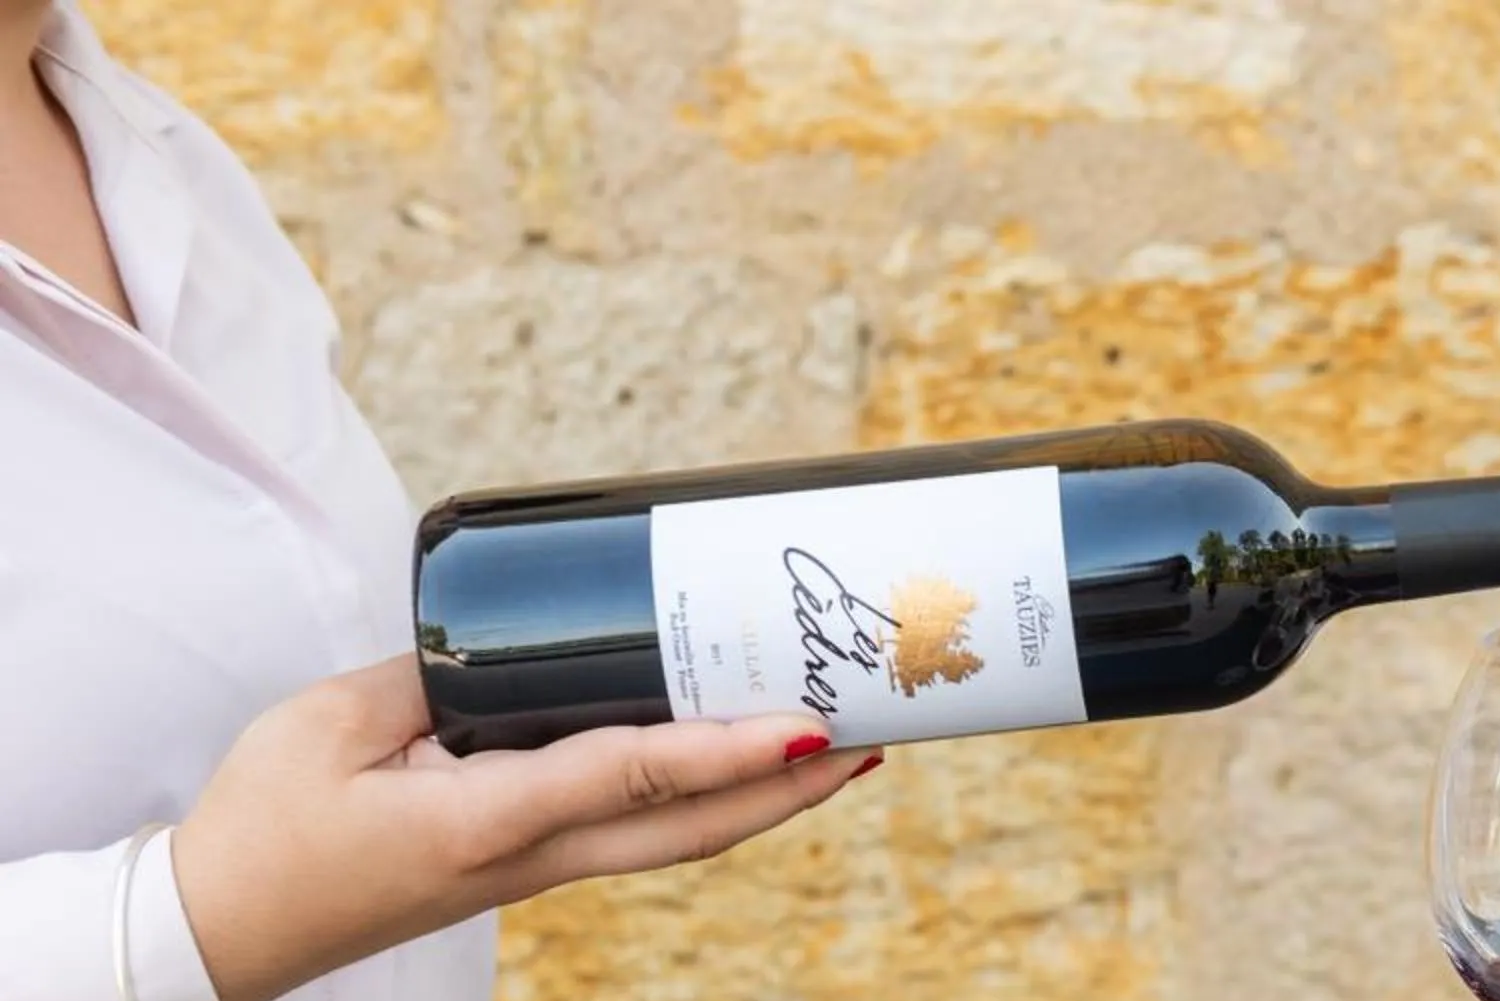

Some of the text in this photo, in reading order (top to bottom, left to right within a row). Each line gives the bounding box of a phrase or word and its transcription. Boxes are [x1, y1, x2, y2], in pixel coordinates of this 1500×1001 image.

[783, 547, 850, 719] Cèdres
[840, 591, 902, 675] Les
[1013, 575, 1041, 667] TAUZIES
